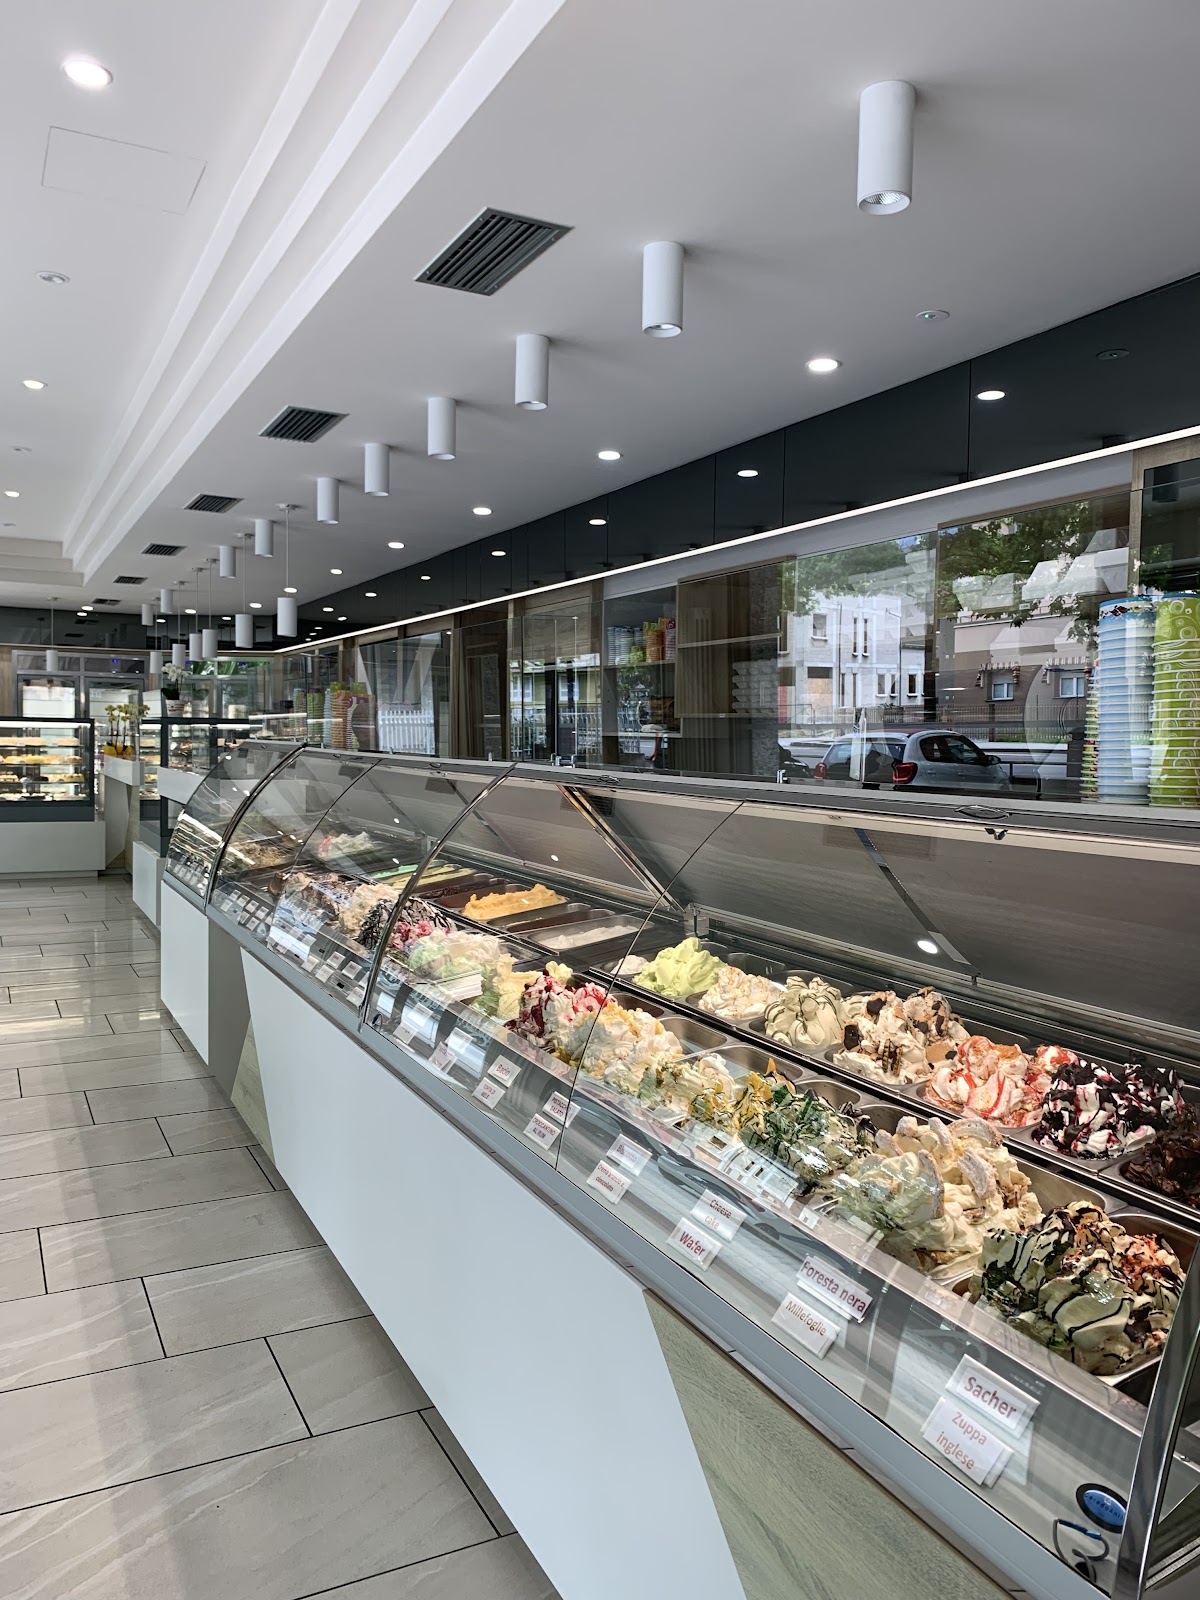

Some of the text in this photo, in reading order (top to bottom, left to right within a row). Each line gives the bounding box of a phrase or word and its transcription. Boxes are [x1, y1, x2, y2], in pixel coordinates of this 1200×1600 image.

[704, 1214, 720, 1230] cake
[709, 1199, 732, 1219] Cheese
[679, 1230, 706, 1257] Wafer
[800, 1260, 867, 1313] Foresta nera
[785, 1300, 827, 1337] Millefoglie
[963, 1375, 1017, 1419] Sacher
[951, 1410, 988, 1446] Zuppa
[936, 1431, 975, 1470] inglese
